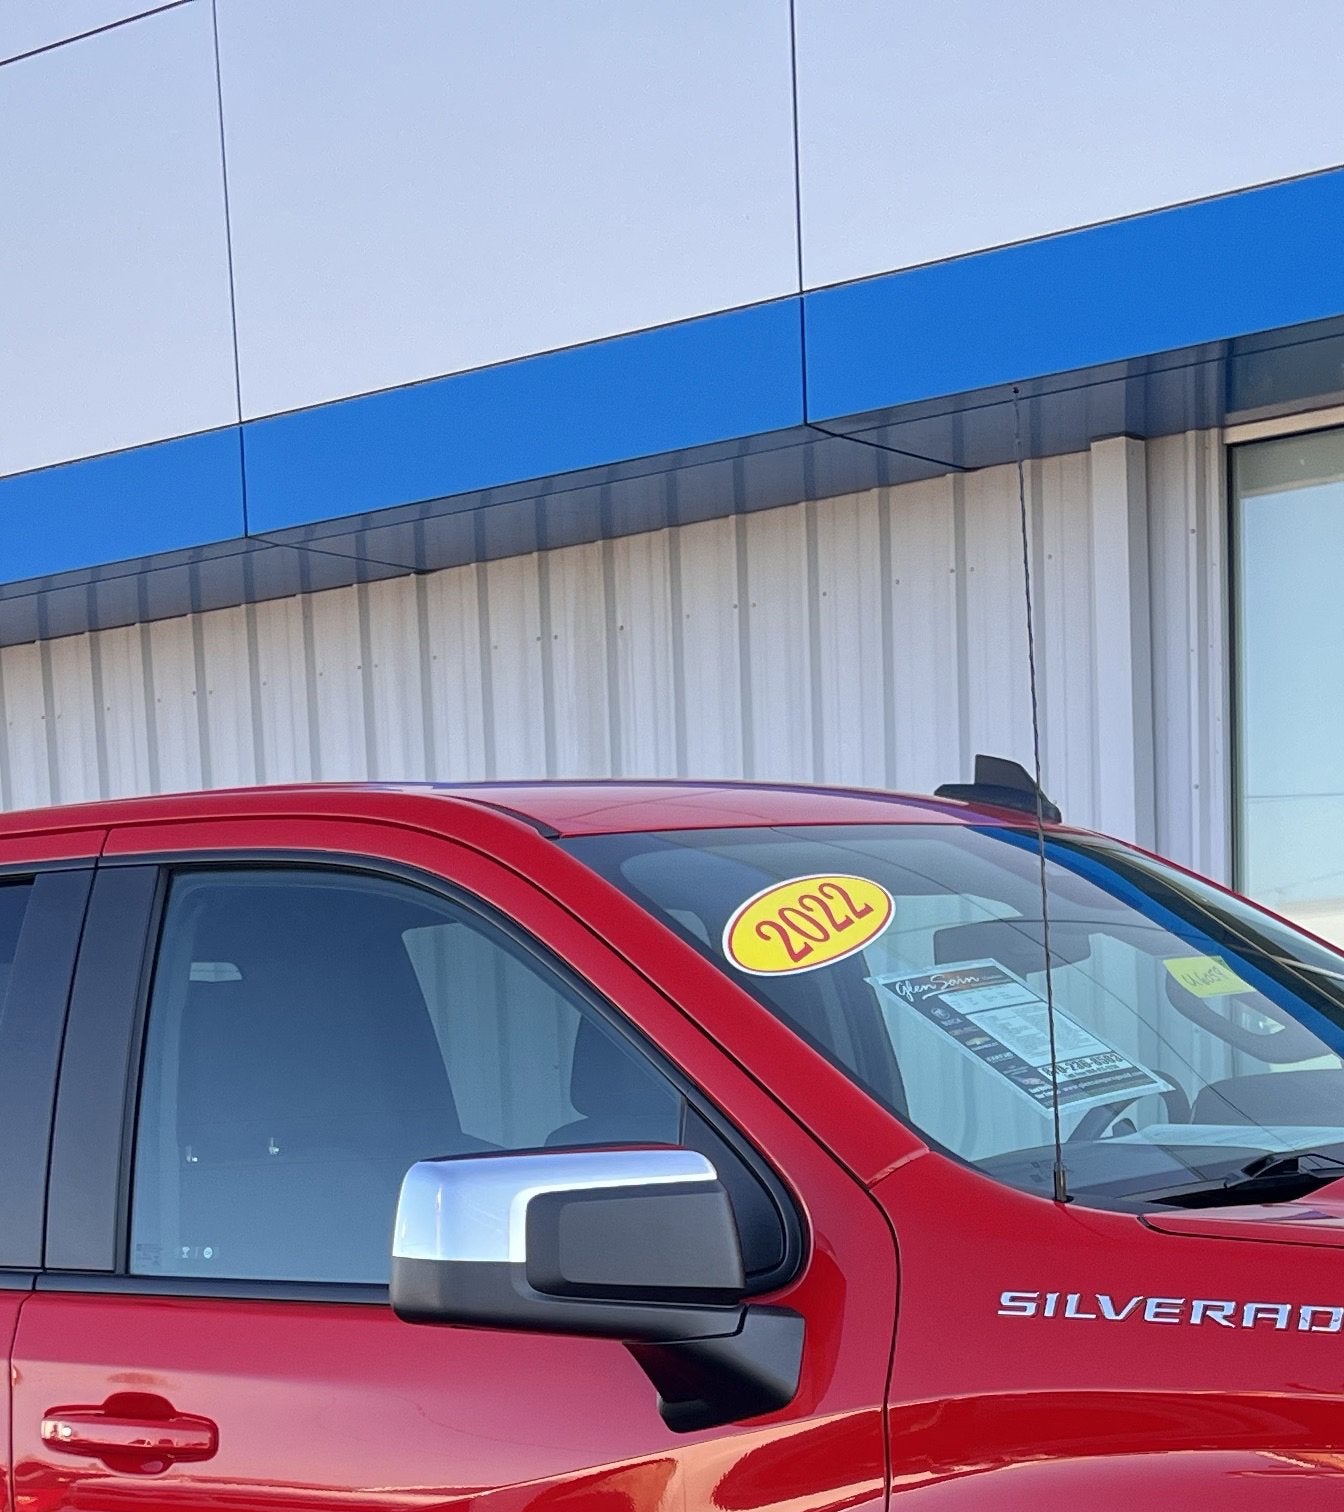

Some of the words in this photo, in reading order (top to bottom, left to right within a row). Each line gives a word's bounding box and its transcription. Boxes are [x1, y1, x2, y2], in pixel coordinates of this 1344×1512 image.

[755, 882, 875, 963] 2022
[895, 979, 937, 1002] Glen
[930, 973, 980, 990] Sain
